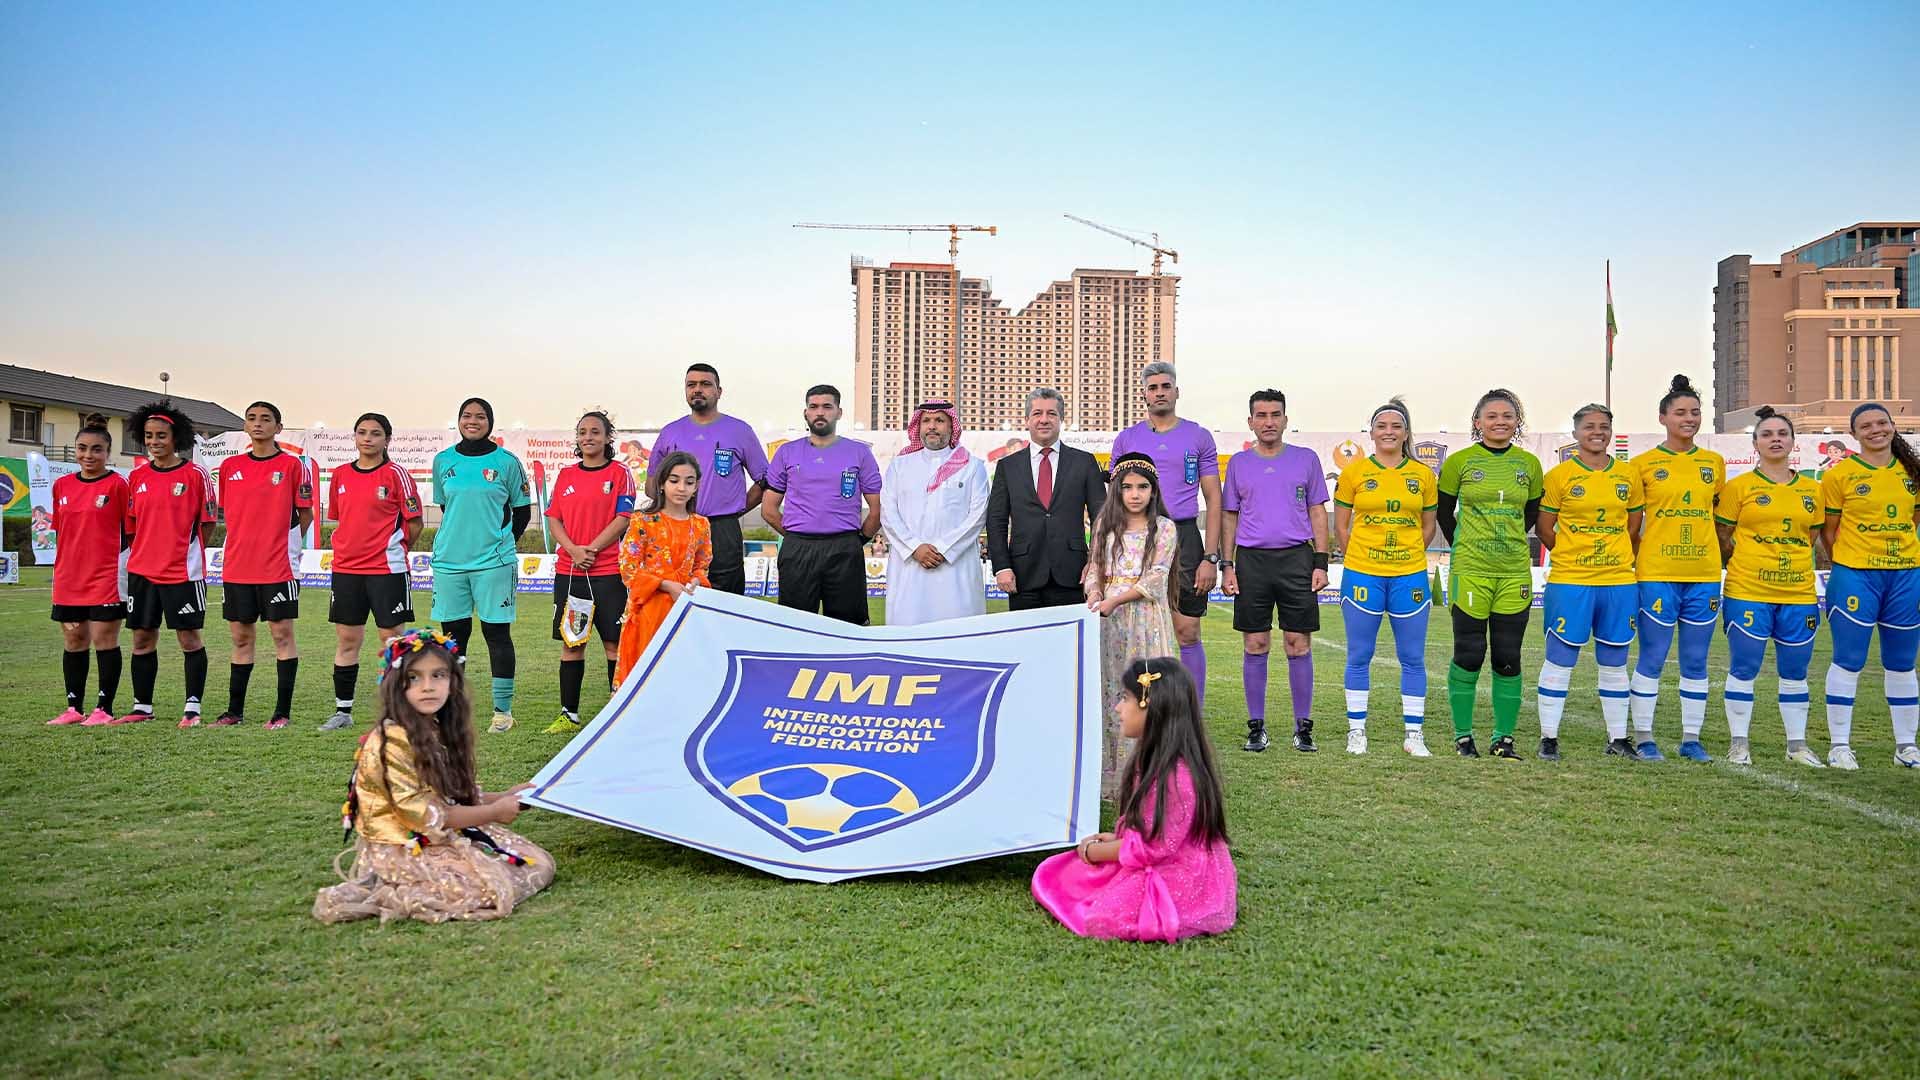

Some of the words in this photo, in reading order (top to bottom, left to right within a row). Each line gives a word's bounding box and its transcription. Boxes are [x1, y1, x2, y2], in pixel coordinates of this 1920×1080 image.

[527, 438, 571, 448] Women's
[526, 450, 547, 459] Mini
[549, 450, 577, 459] footb
[526, 462, 555, 471] Wld
[1497, 490, 1504, 505] 1
[1682, 491, 1691, 505] 4
[1386, 500, 1401, 513] 10
[1887, 504, 1897, 518] 9
[1596, 508, 1606, 522] 2
[1782, 518, 1793, 533] 5
[1758, 568, 1806, 584] Fomentas
[1353, 586, 1368, 602] 10
[1466, 591, 1473, 607] 1
[1651, 598, 1662, 614] 4
[1847, 595, 1859, 612] 9
[1556, 617, 1566, 633] 2
[1743, 611, 1754, 627] 5
[788, 668, 941, 706] IMF
[763, 706, 946, 729] INTERNATIONAL
[763, 719, 937, 741] MINIFOOTBALL
[771, 733, 920, 754] FEDERATION
